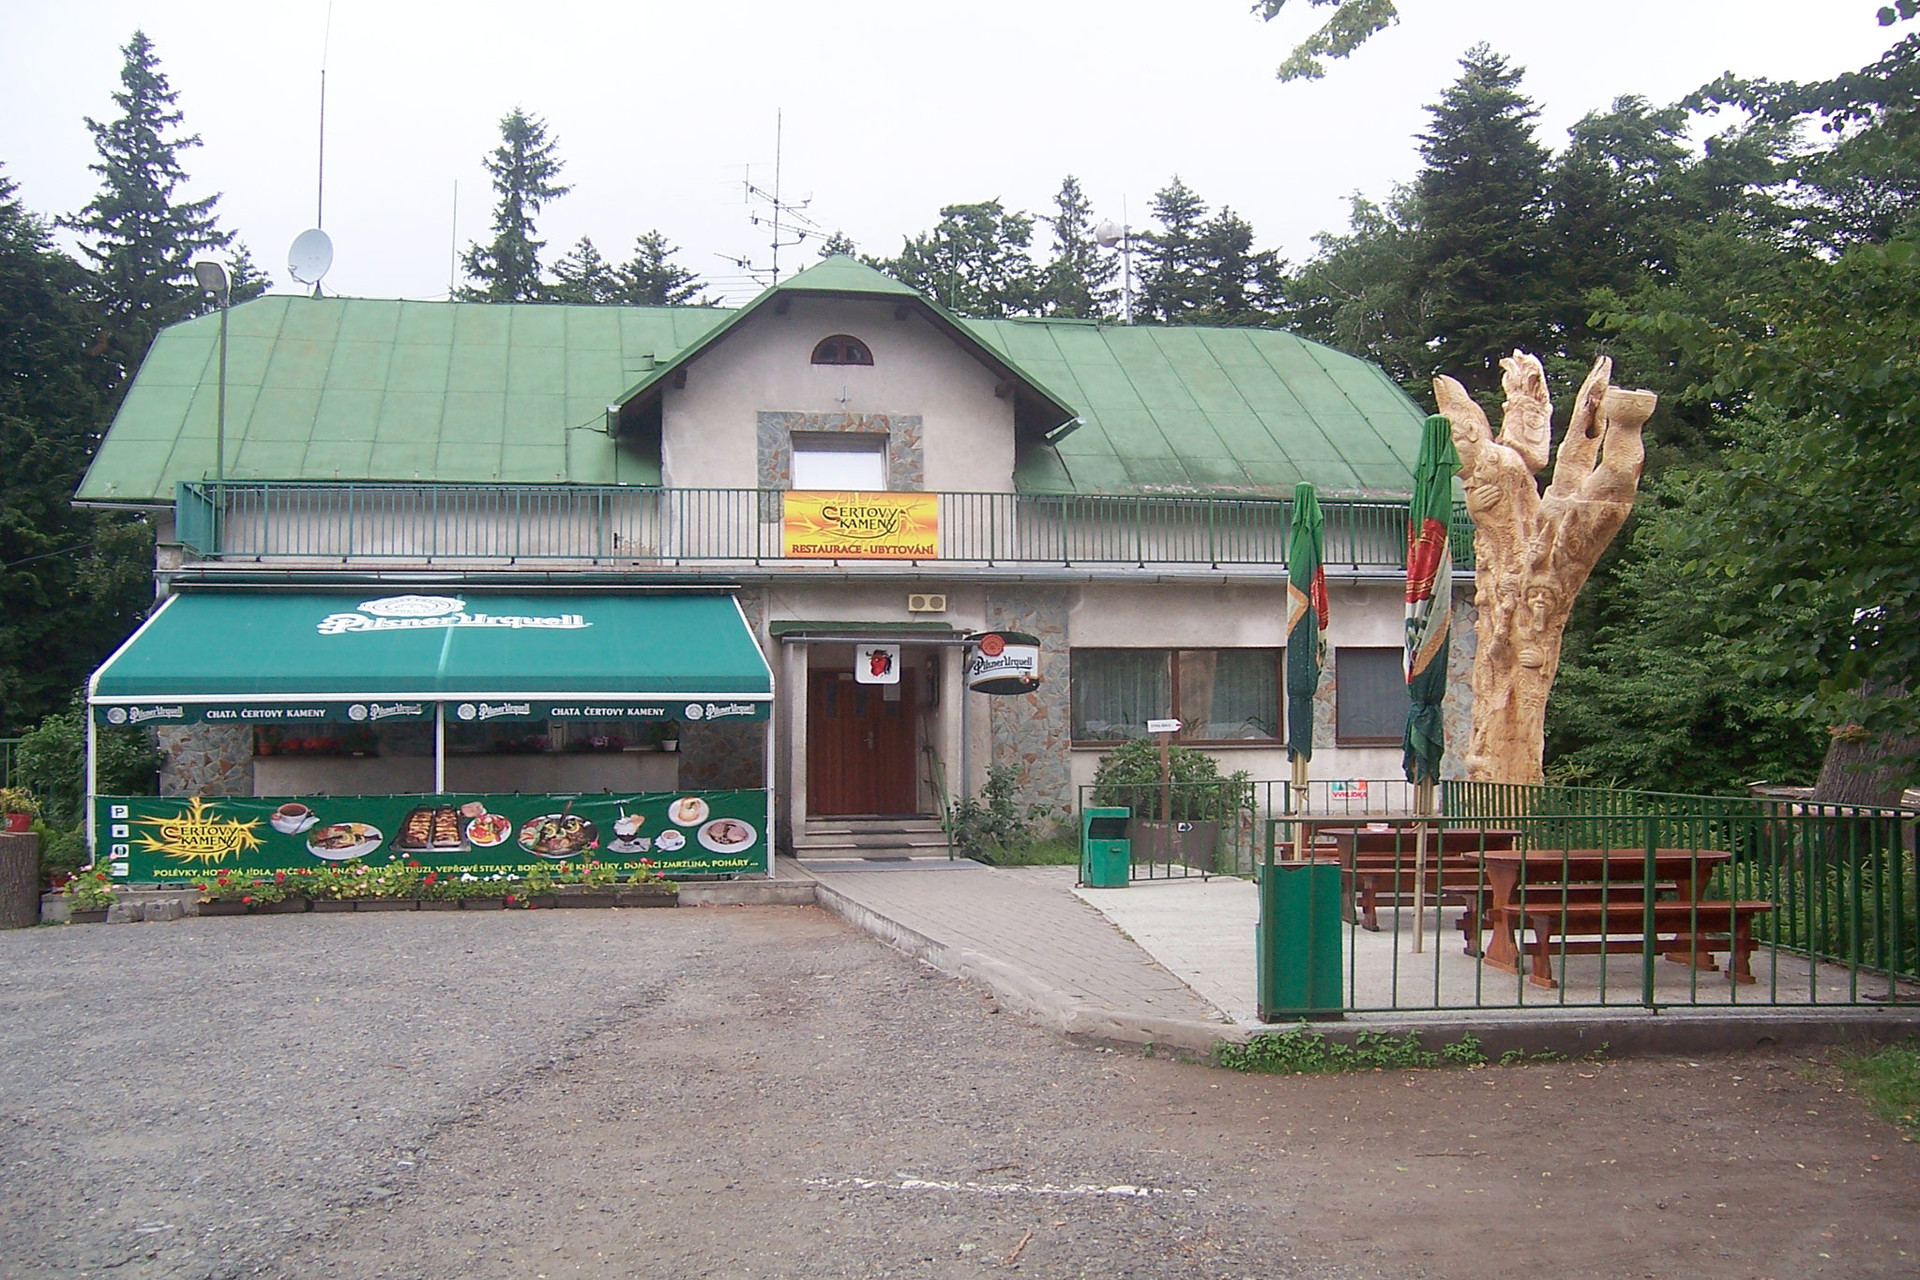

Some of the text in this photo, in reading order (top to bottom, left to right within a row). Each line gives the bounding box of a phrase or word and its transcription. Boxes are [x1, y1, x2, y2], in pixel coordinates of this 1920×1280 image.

[840, 518, 898, 532] KAMENY
[792, 544, 862, 554] RESTAURACE
[870, 543, 934, 555] UBYTOVÁNÍ
[317, 612, 586, 635] Pilsner Urquell
[973, 655, 1033, 675] Pilsner Urquell
[206, 708, 326, 719] CHATA ČERTOVY KAMENY
[551, 706, 665, 716] CHATA ČERTOVY KAMENY
[181, 836, 238, 847] KAMENY
[154, 868, 201, 877] POLÉVKY,
[480, 864, 515, 873] STEAKY,
[663, 859, 710, 869] ZMRZLINA,
[711, 858, 749, 867] POHÁRY
